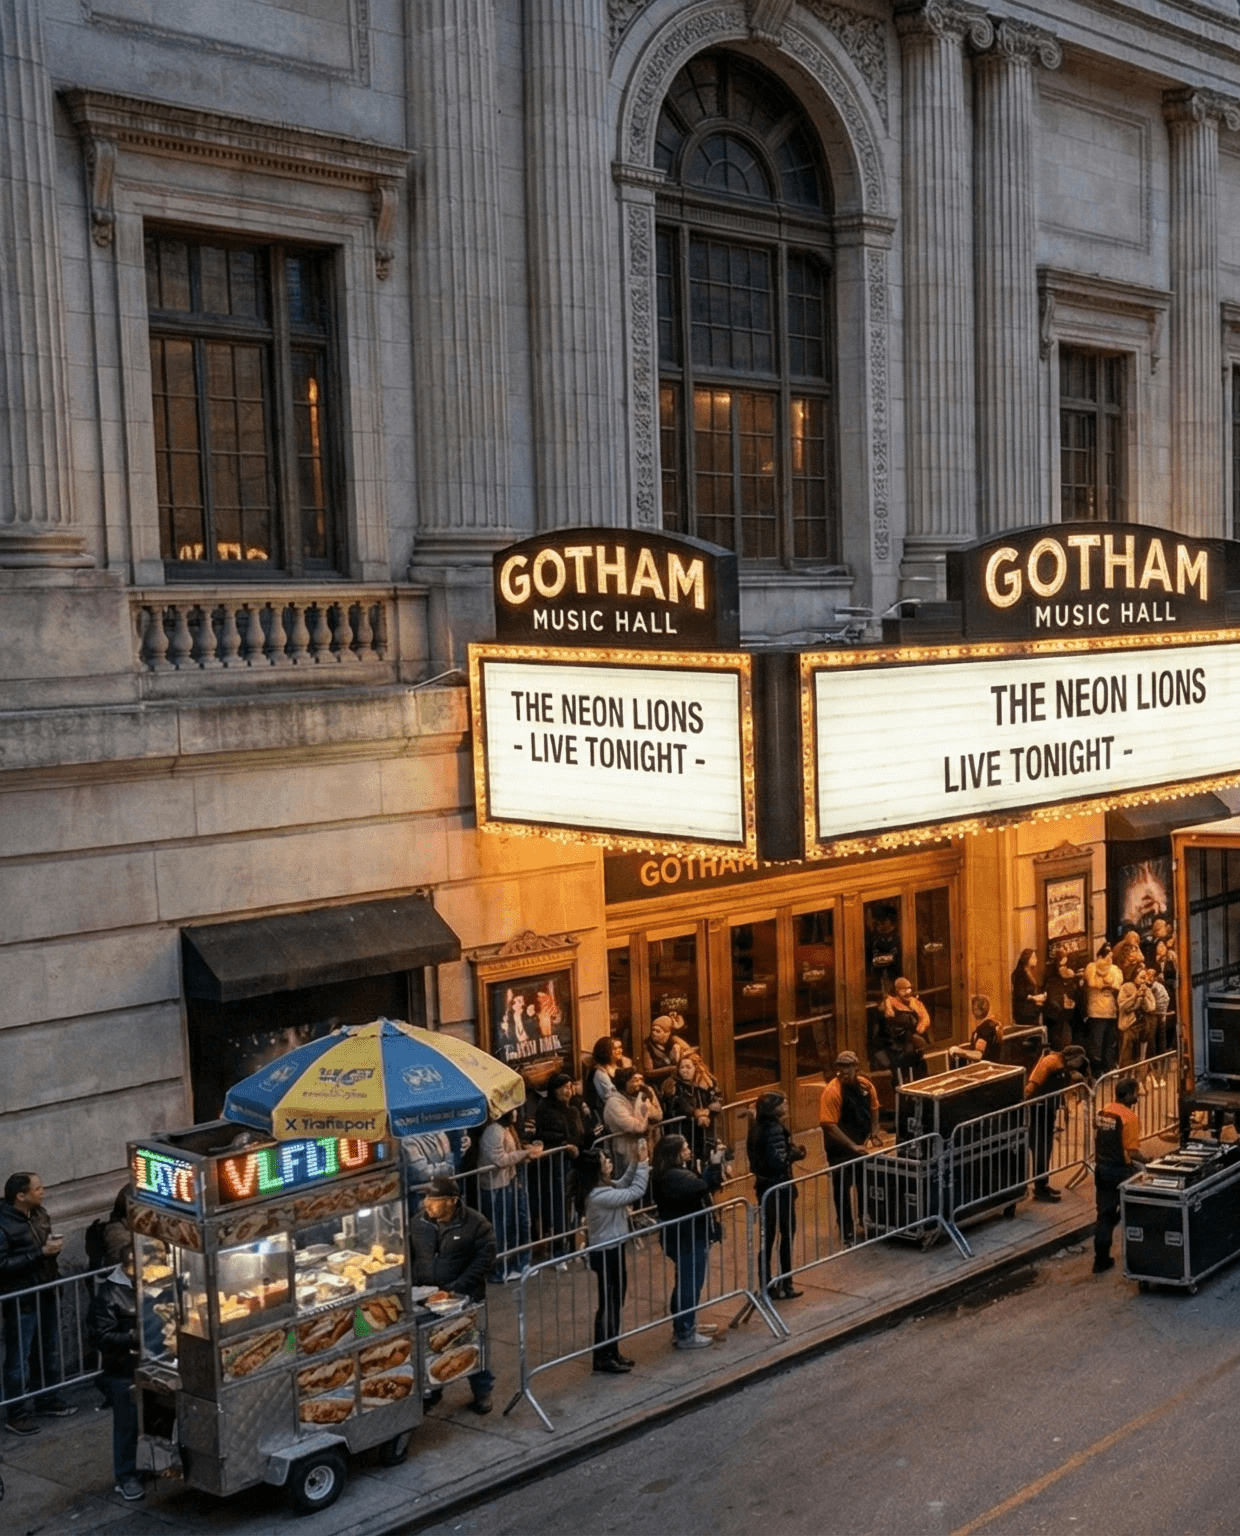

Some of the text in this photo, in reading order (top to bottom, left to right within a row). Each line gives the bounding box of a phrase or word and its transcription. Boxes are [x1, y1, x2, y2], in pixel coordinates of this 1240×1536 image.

[500, 545, 705, 610] GOTHAM
[985, 534, 1208, 608] GOTHAM
[533, 609, 677, 634] MUSIC HALL
[1035, 601, 1176, 628] MUSIC HALL
[511, 691, 704, 734] THE NEON LIONS
[990, 667, 1206, 726] THE NEON LIONS
[530, 732, 578, 765] LIVE
[585, 736, 687, 774] TONIGHT
[944, 750, 1002, 793] LIVE
[1009, 735, 1115, 782] TONIGHT
[285, 1118, 298, 1131] X
